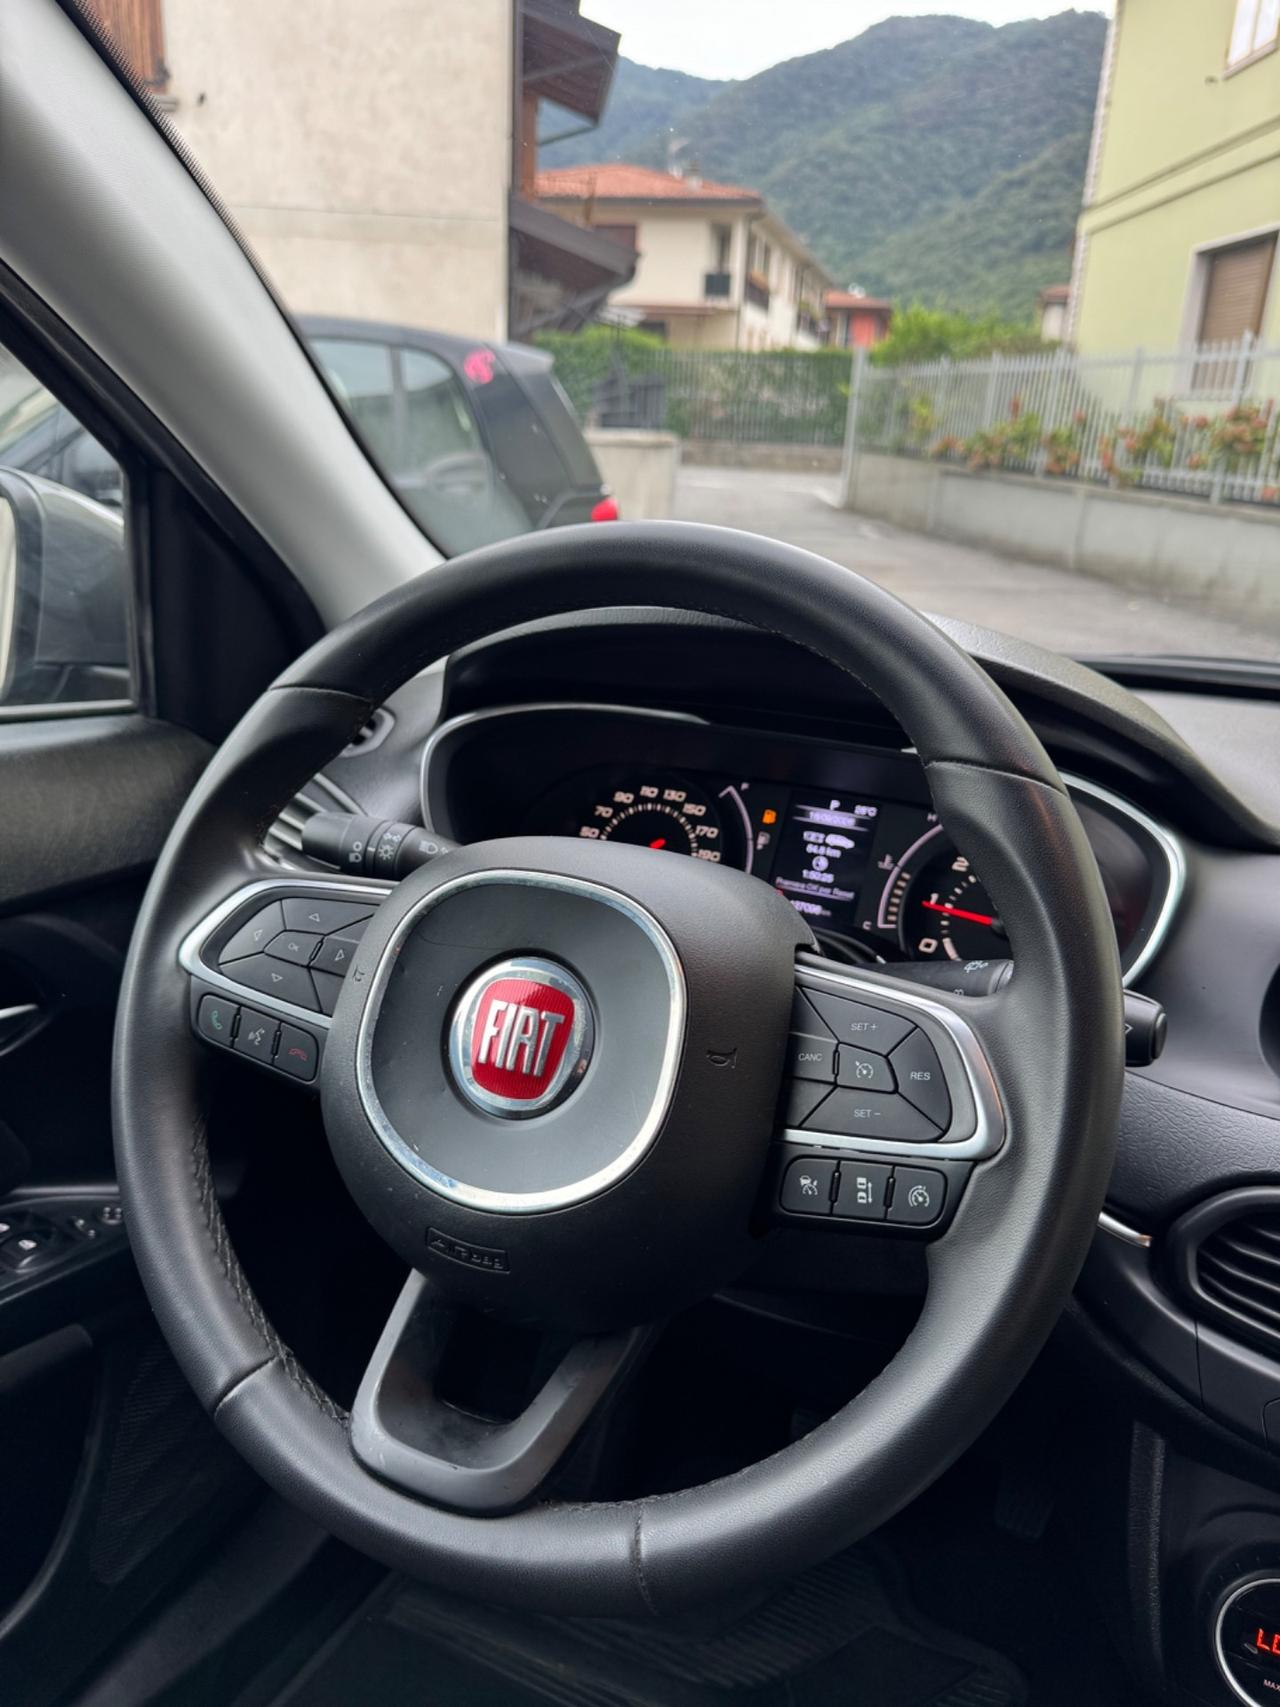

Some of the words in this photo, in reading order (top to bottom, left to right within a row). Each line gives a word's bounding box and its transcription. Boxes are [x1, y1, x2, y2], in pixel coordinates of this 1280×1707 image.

[830, 799, 841, 811] P
[594, 805, 613, 818] 70
[695, 825, 719, 838] 170
[952, 856, 970, 872] 2
[862, 921, 872, 931] C
[918, 938, 938, 954] 0
[850, 1022, 870, 1031] SET
[477, 999, 566, 1077] FIAT
[798, 1053, 823, 1062] CANC
[909, 1071, 931, 1081] RES
[853, 1109, 872, 1118] SET
